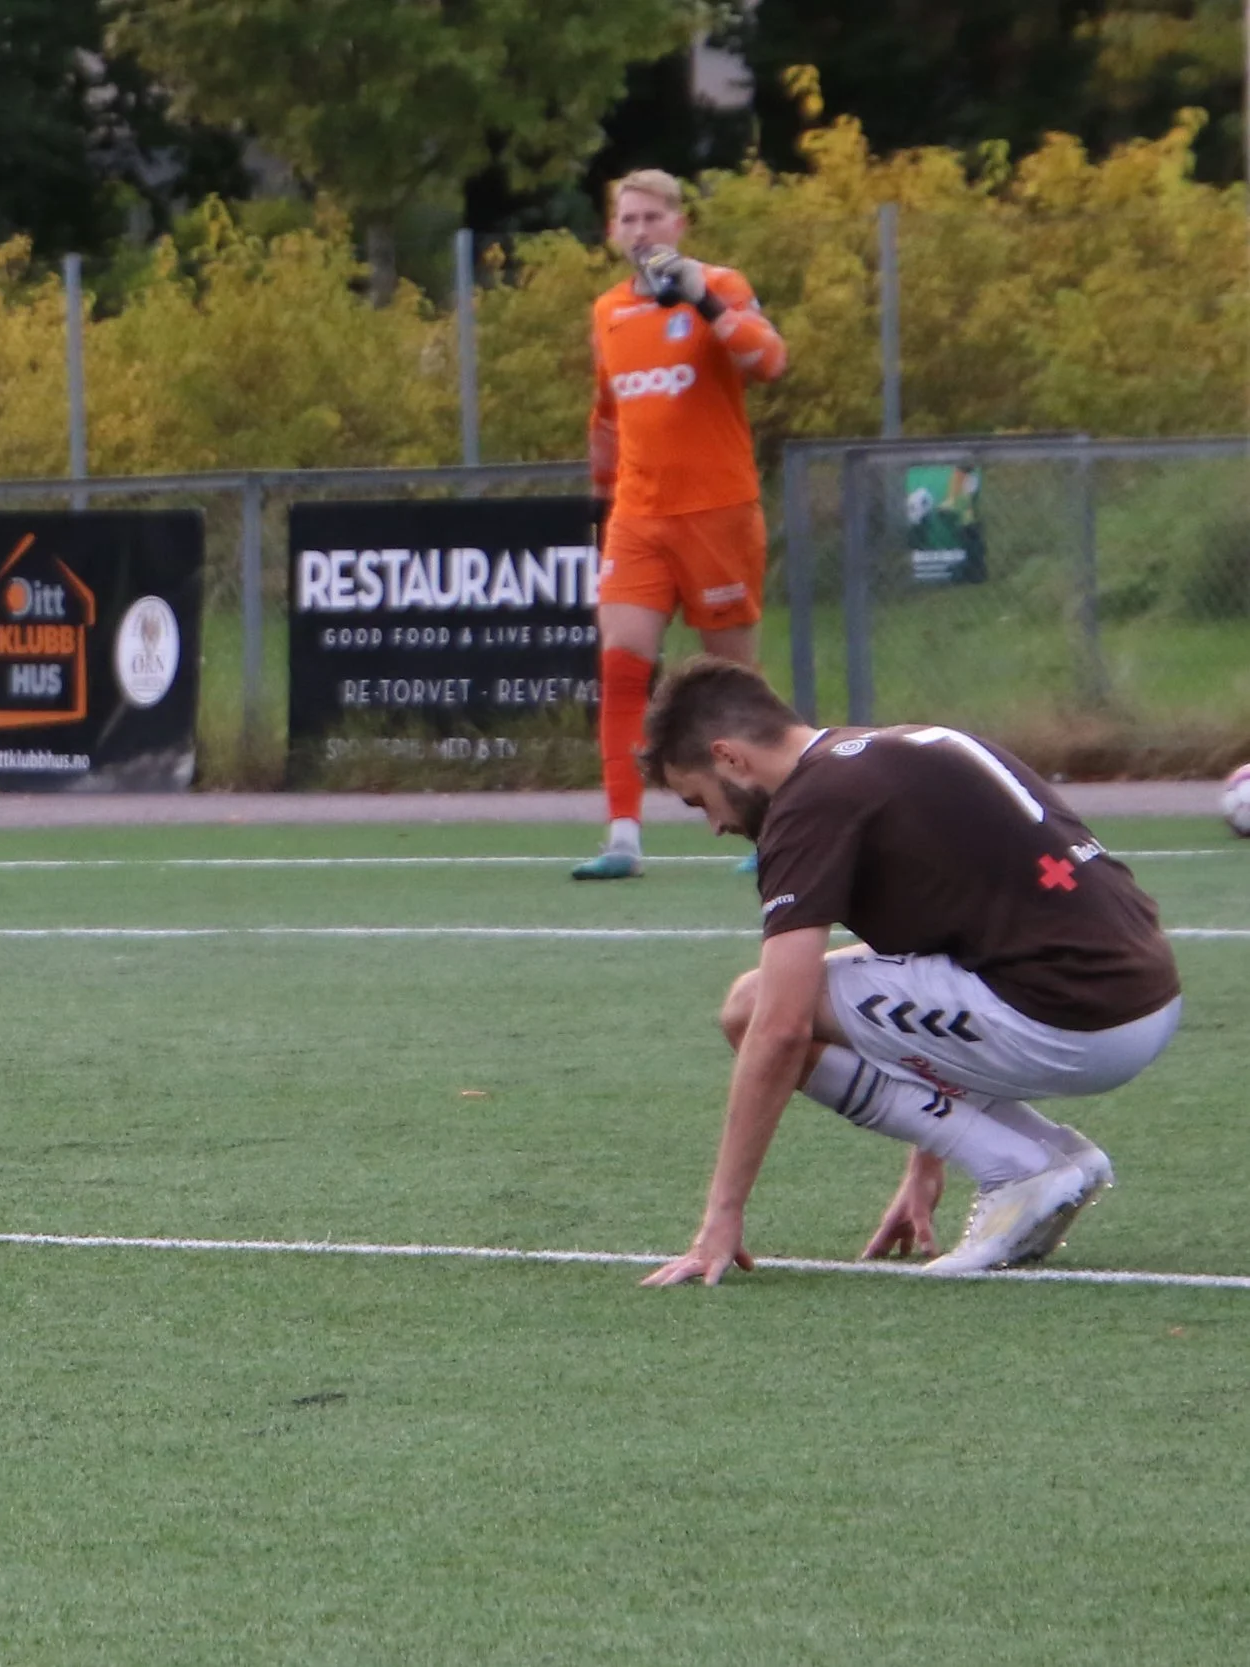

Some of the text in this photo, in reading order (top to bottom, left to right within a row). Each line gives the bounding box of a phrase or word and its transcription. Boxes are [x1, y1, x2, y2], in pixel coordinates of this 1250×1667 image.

[612, 364, 696, 397] coop
[298, 546, 600, 610] RESTAURANT
[6, 577, 65, 617] Ditt
[323, 627, 382, 648] GOOD
[394, 626, 450, 647] FOOD
[485, 625, 531, 646] LIVE
[543, 624, 597, 645] SPOR
[9, 663, 62, 695] HUS
[342, 678, 472, 704] RE-TORVET
